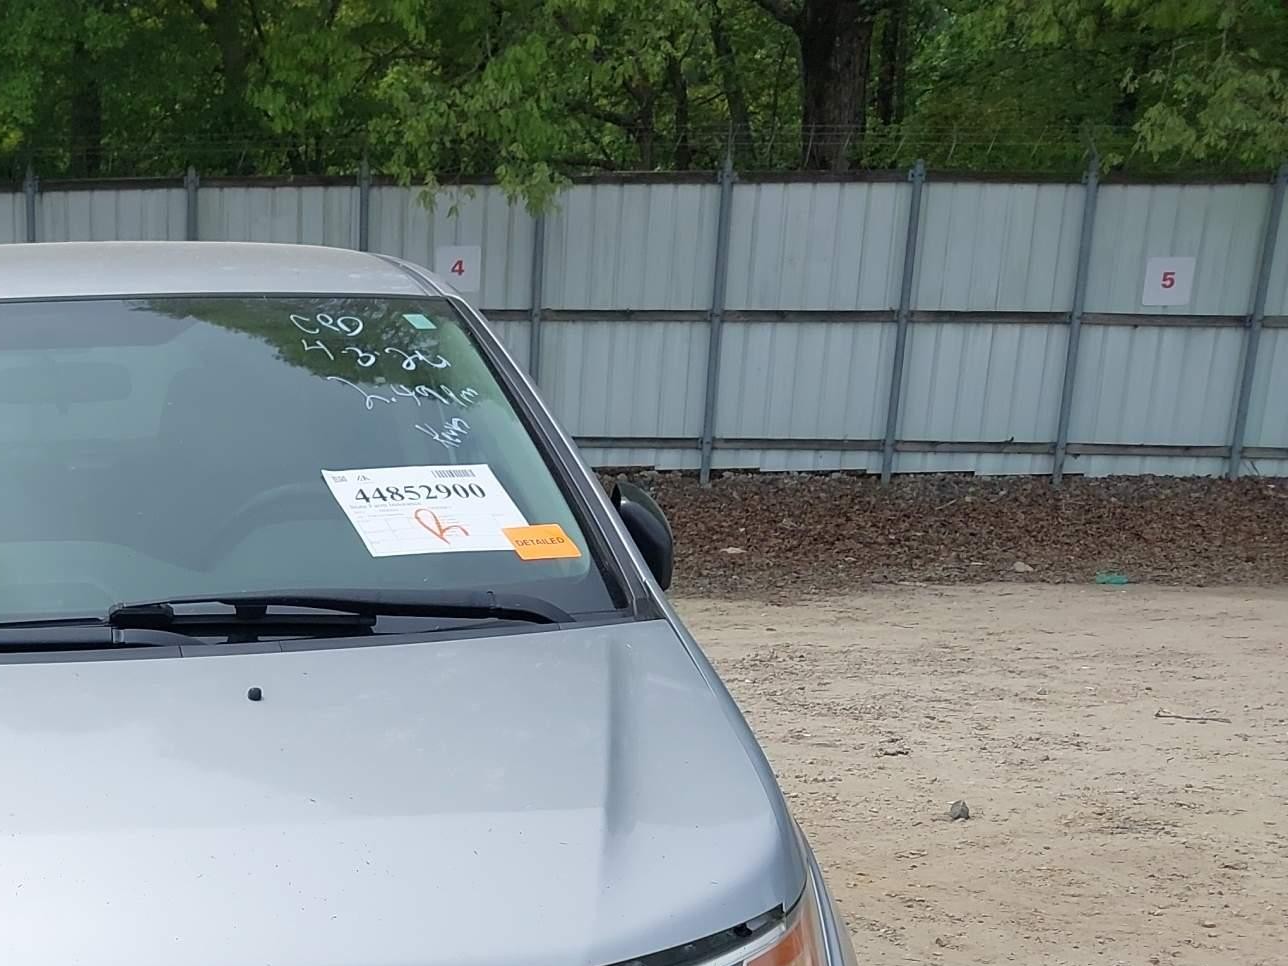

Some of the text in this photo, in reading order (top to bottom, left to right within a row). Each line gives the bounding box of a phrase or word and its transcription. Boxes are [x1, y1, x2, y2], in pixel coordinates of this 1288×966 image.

[451, 260, 464, 276] 4
[1161, 271, 1176, 289] 5
[354, 483, 487, 503] 44852900
[515, 536, 565, 547] DETAILED
